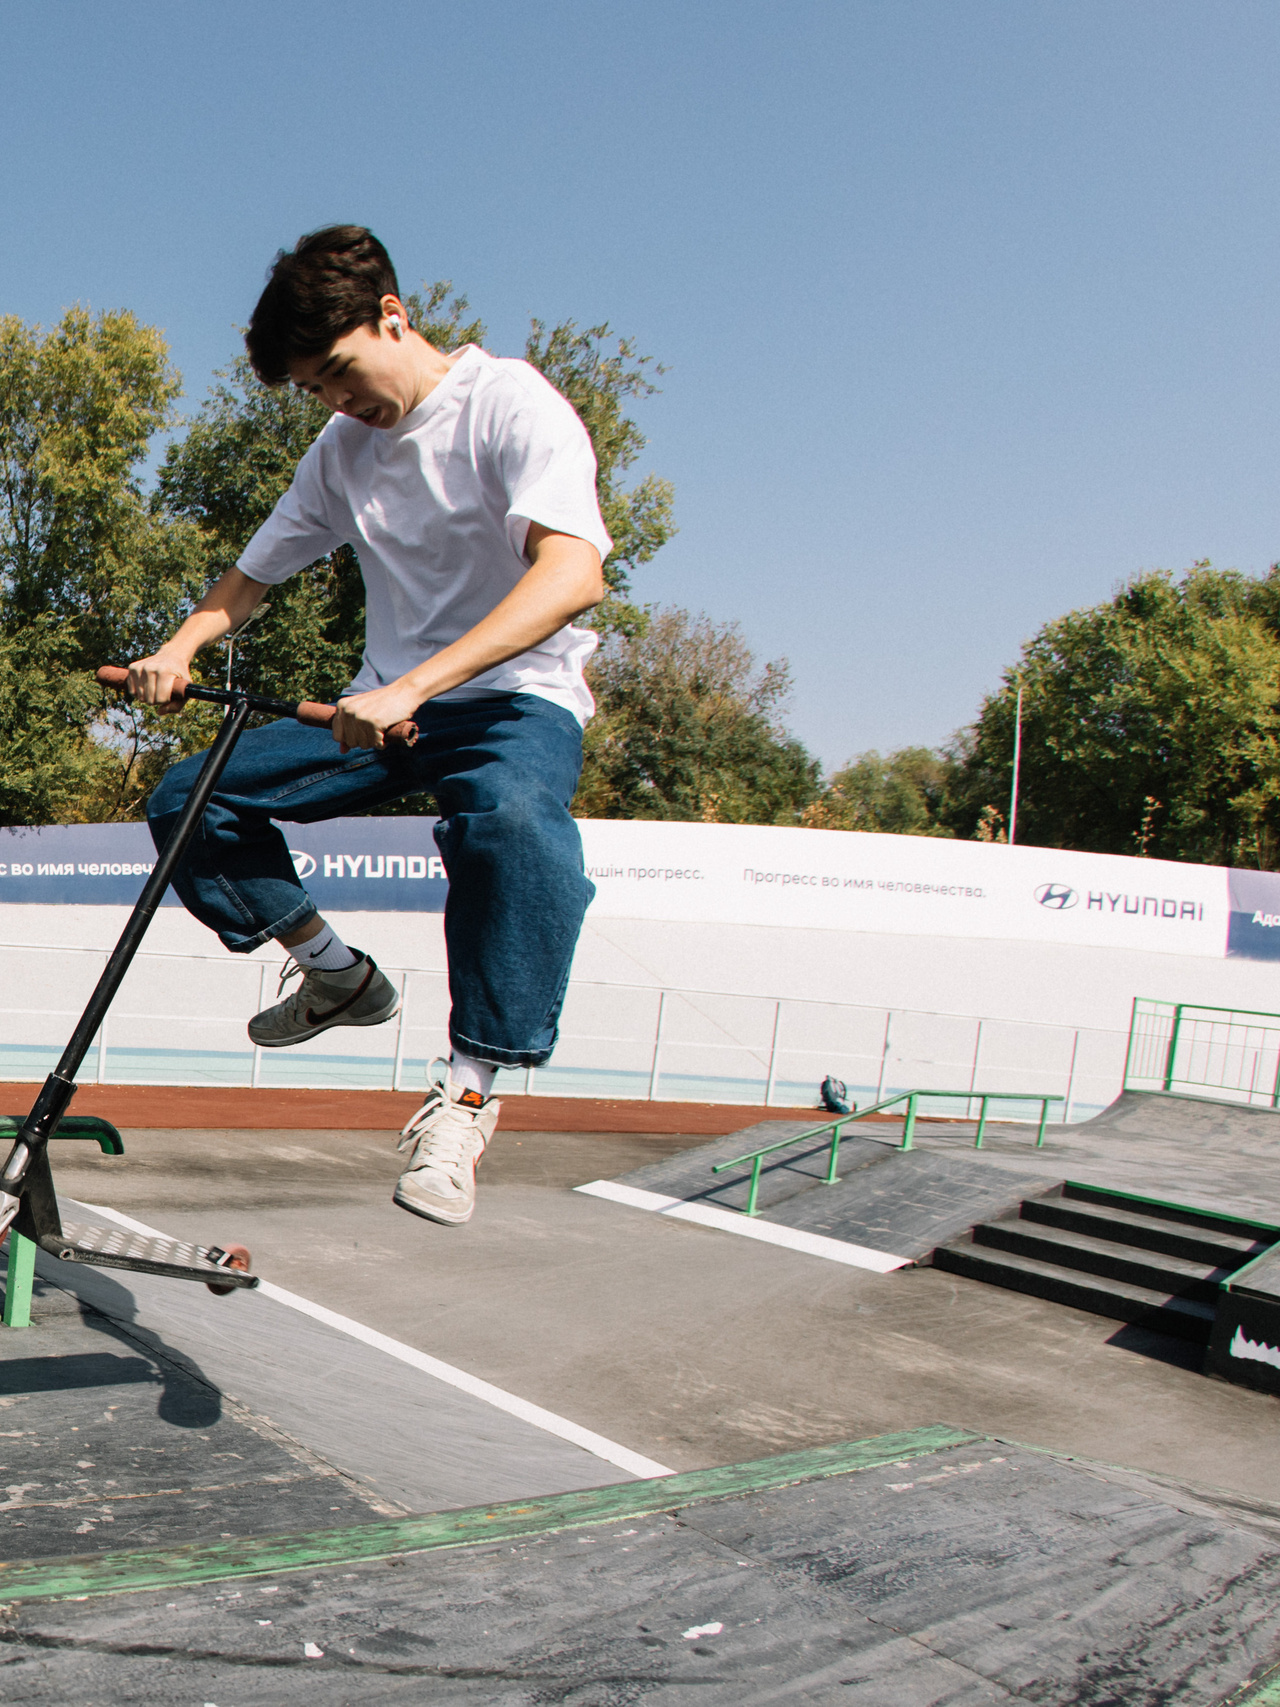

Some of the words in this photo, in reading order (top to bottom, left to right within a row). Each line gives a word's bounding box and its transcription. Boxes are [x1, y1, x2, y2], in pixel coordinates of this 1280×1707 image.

[10, 863, 34, 876] во
[37, 863, 74, 876] имя
[78, 862, 155, 876] человеч
[323, 854, 448, 879] HYUNDA
[628, 867, 704, 882] прогресс.
[743, 868, 818, 887] Прогресс
[821, 875, 840, 888] во
[843, 877, 874, 890] имя
[877, 879, 987, 899] человечества.
[1087, 890, 1204, 922] HYUNDAI
[1252, 910, 1280, 928] Ада
